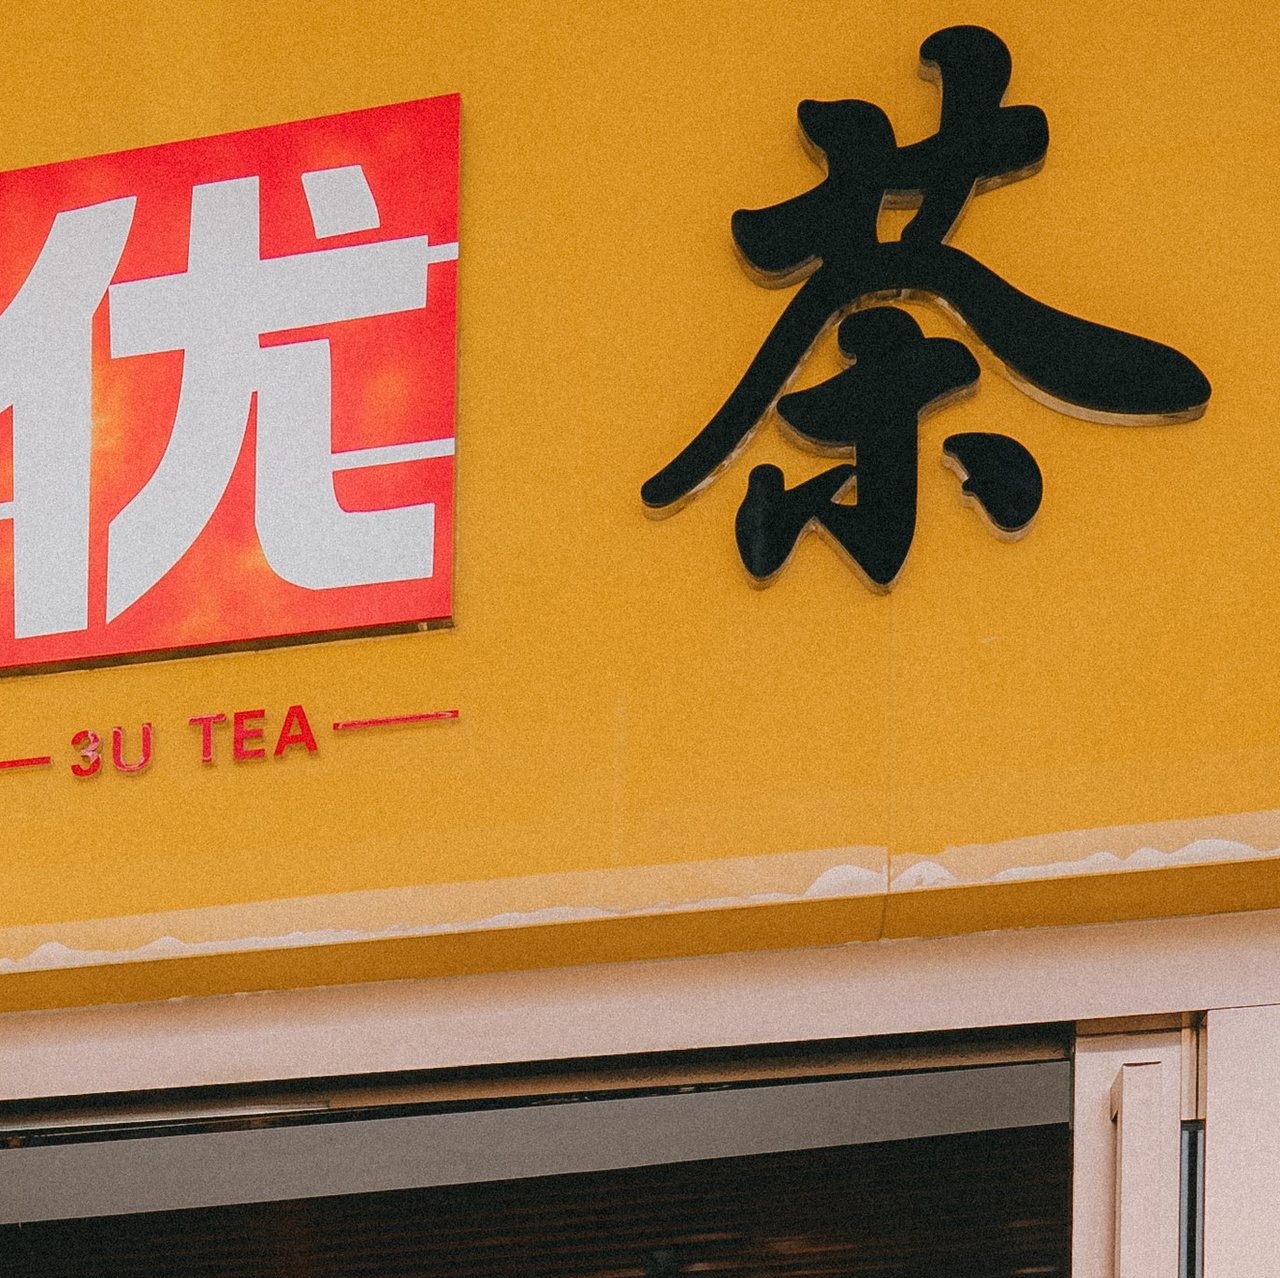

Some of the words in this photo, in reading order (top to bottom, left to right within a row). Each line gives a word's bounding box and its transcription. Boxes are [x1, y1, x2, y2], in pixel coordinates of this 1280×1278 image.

[641, 24, 1212, 588] 茶
[70, 722, 153, 778] 3U
[187, 703, 319, 764] TEA
